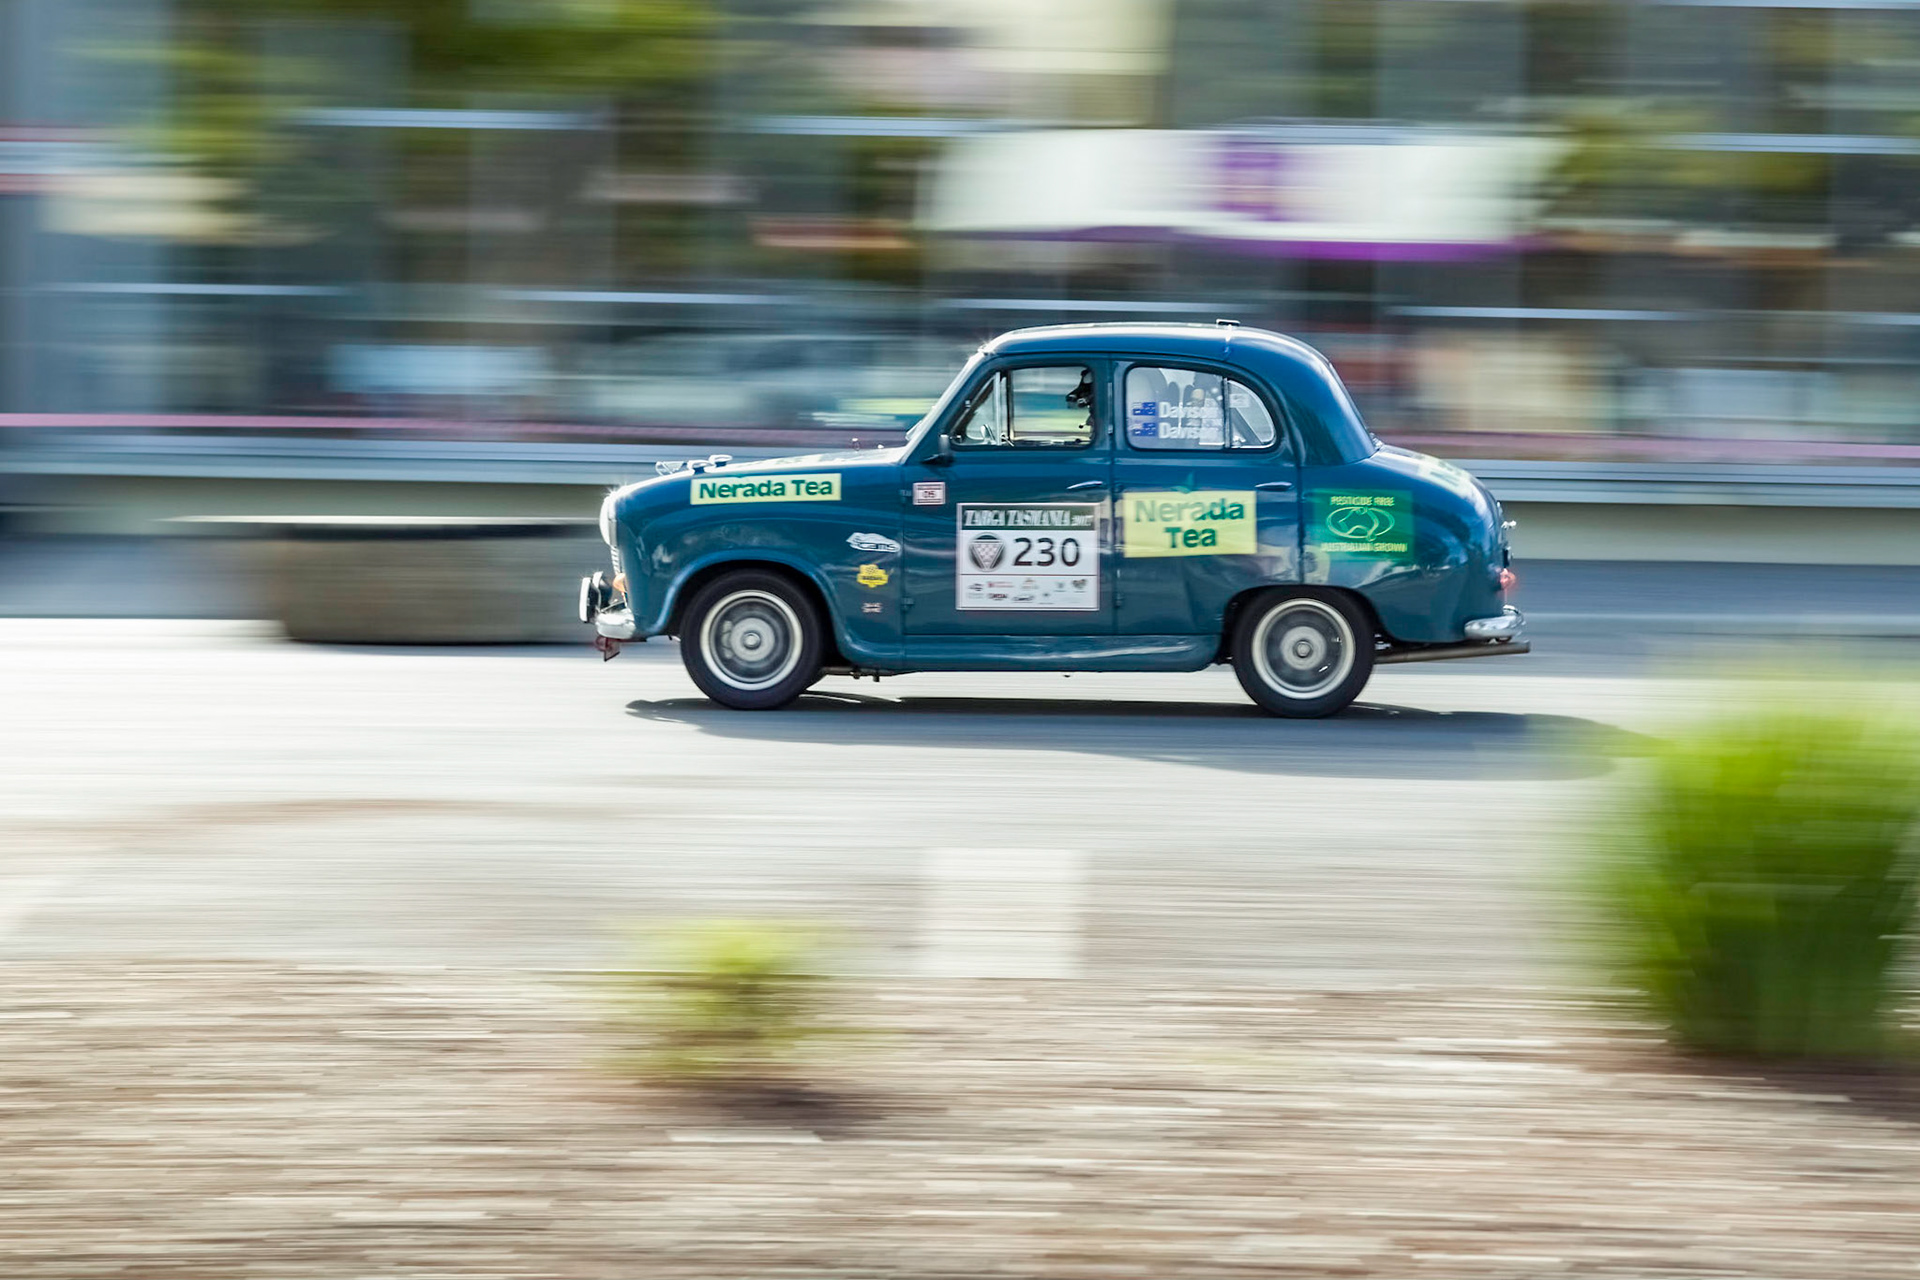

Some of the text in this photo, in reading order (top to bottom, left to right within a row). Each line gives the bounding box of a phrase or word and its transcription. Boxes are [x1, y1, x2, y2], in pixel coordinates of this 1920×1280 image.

[699, 479, 832, 499] Nerada Tea
[964, 509, 1005, 526] TARGA
[1006, 509, 1070, 526] TASMANIA
[1135, 498, 1245, 522] Nerada
[1164, 526, 1217, 549] Tea
[1013, 537, 1080, 566] 230
